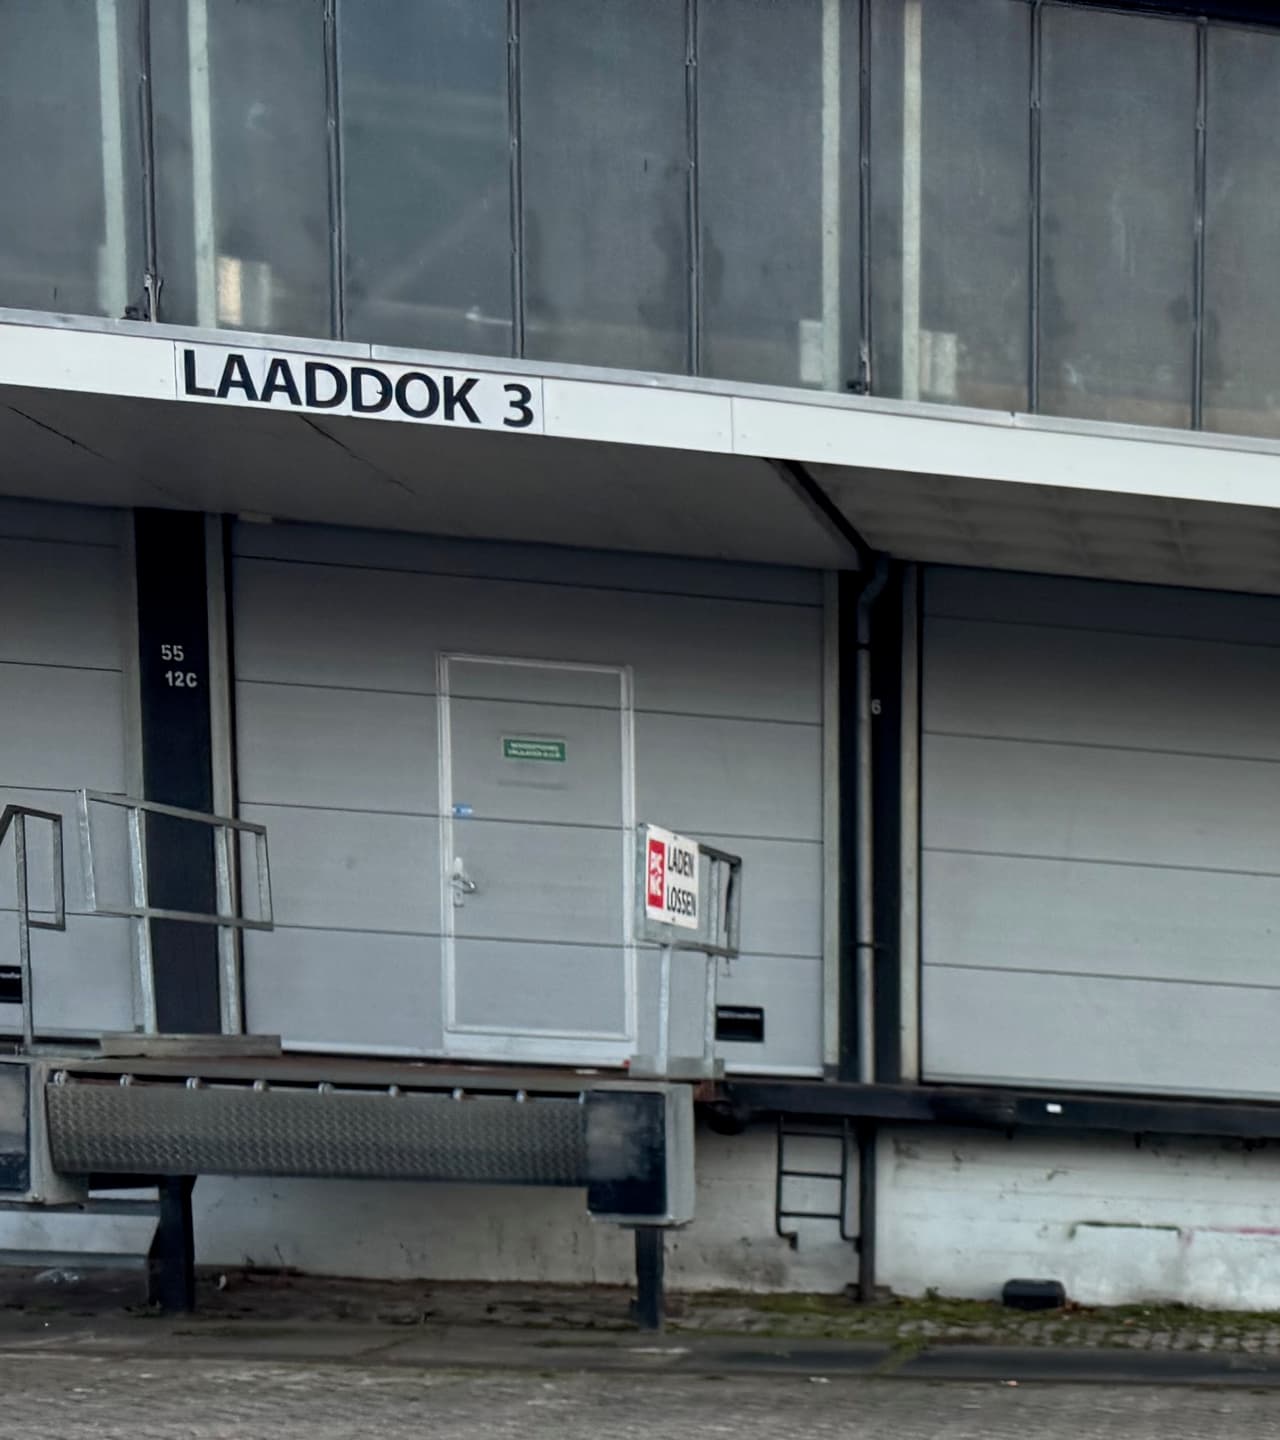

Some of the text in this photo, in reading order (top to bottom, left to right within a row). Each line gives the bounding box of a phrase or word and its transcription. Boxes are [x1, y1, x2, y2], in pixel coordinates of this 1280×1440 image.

[183, 349, 535, 428] LAADDOK 3
[161, 644, 184, 661] 55
[165, 670, 197, 688] 12C
[667, 845, 695, 878] LADEN
[667, 885, 697, 917] LOSSEN
